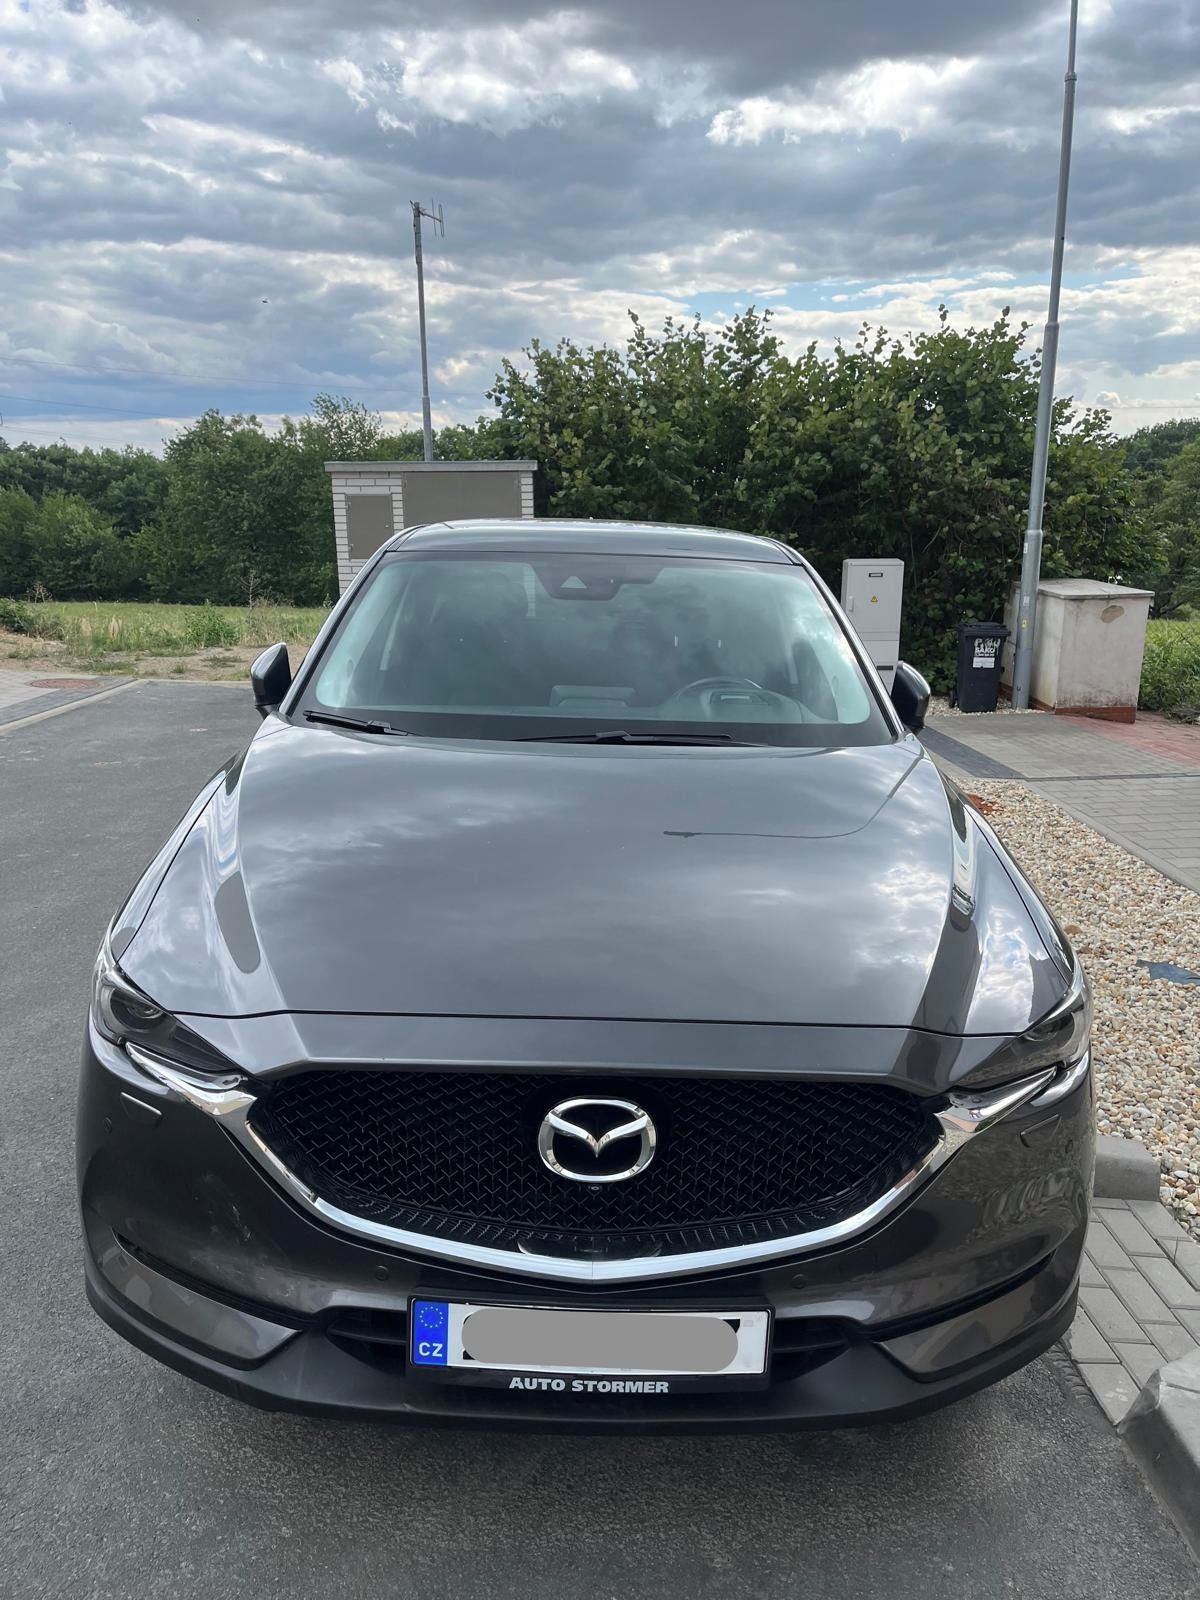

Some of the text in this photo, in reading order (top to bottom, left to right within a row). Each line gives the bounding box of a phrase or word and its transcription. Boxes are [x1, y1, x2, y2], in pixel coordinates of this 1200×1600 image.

[418, 1341, 443, 1357] CZ
[508, 1377, 669, 1393] AUTO STORMER
